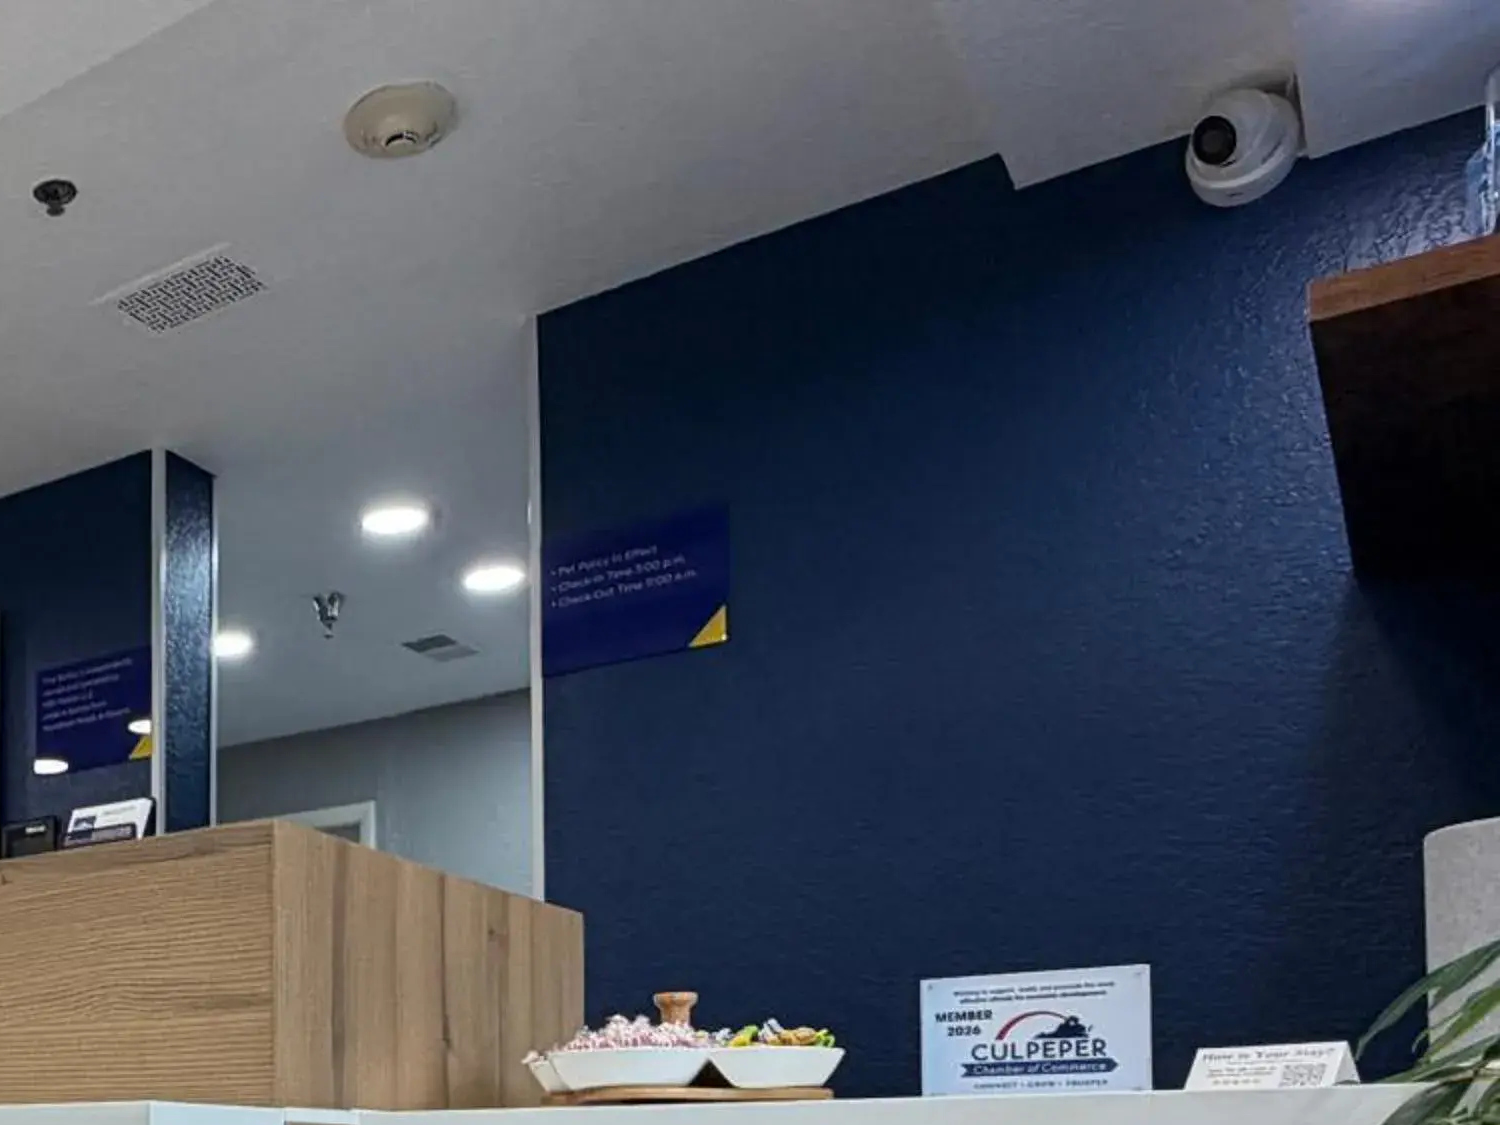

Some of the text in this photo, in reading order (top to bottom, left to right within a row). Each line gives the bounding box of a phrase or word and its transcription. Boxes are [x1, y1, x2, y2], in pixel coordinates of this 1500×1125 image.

[935, 1009, 993, 1023] MEMBER
[947, 1025, 981, 1037] 2026
[971, 1039, 1107, 1061] CULPEPER
[973, 1062, 1107, 1075] Chamber of Commerce
